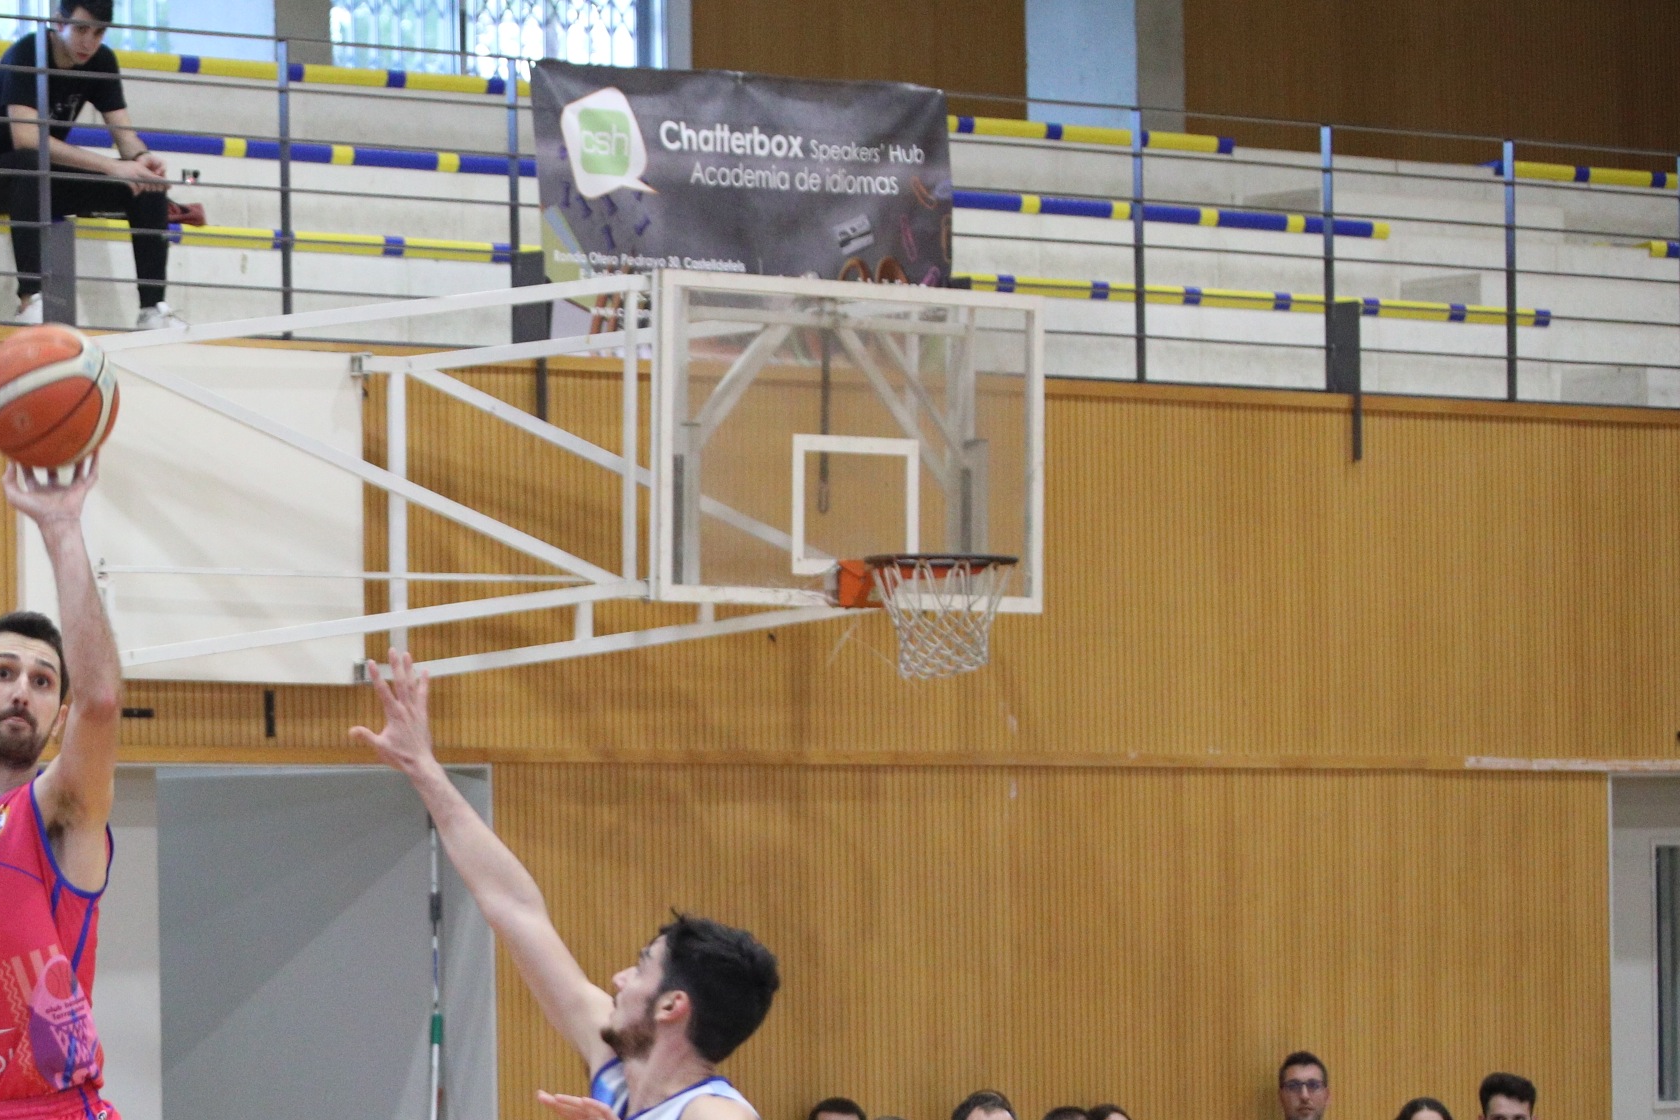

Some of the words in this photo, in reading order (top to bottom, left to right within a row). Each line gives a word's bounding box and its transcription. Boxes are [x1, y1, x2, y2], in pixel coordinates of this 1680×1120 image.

[580, 124, 630, 156] csh
[659, 120, 805, 158] Chatterbox
[888, 144, 926, 164] Hub
[690, 161, 790, 190] Academia
[795, 167, 820, 192] de
[825, 167, 900, 195] idiomas
